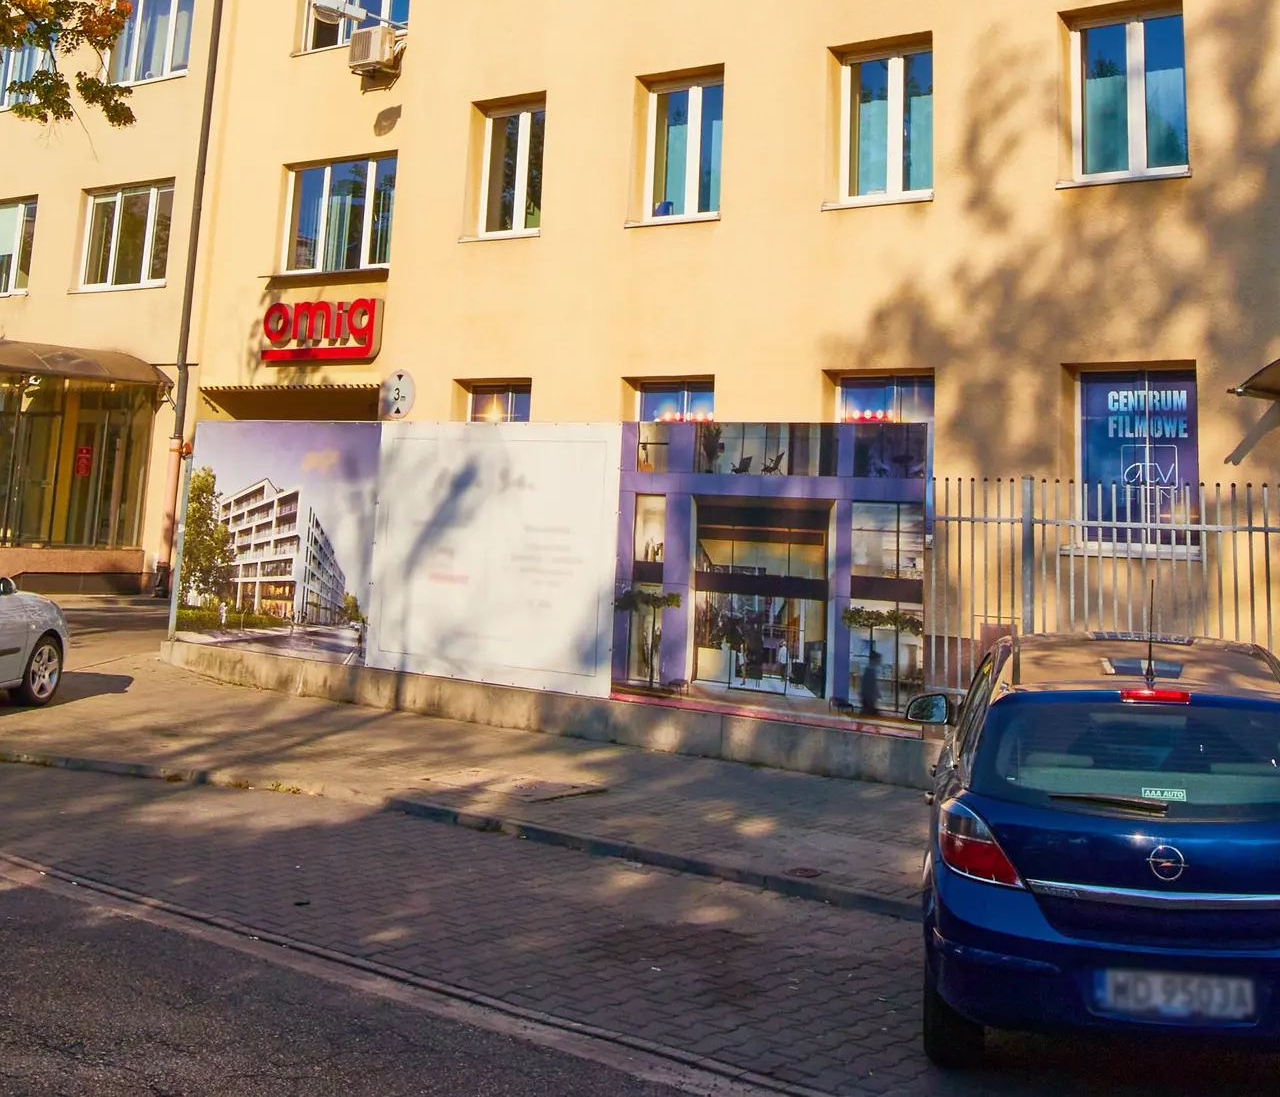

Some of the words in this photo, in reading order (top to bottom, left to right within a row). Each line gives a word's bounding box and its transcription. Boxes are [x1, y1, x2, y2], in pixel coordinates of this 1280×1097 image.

[261, 298, 377, 361] omig
[1107, 390, 1187, 412] CENTRUM
[1107, 416, 1189, 438] FILMOWE
[1144, 789, 1161, 798] AAA
[1163, 790, 1184, 799] AUTO
[1042, 886, 1079, 898] ASTRA
